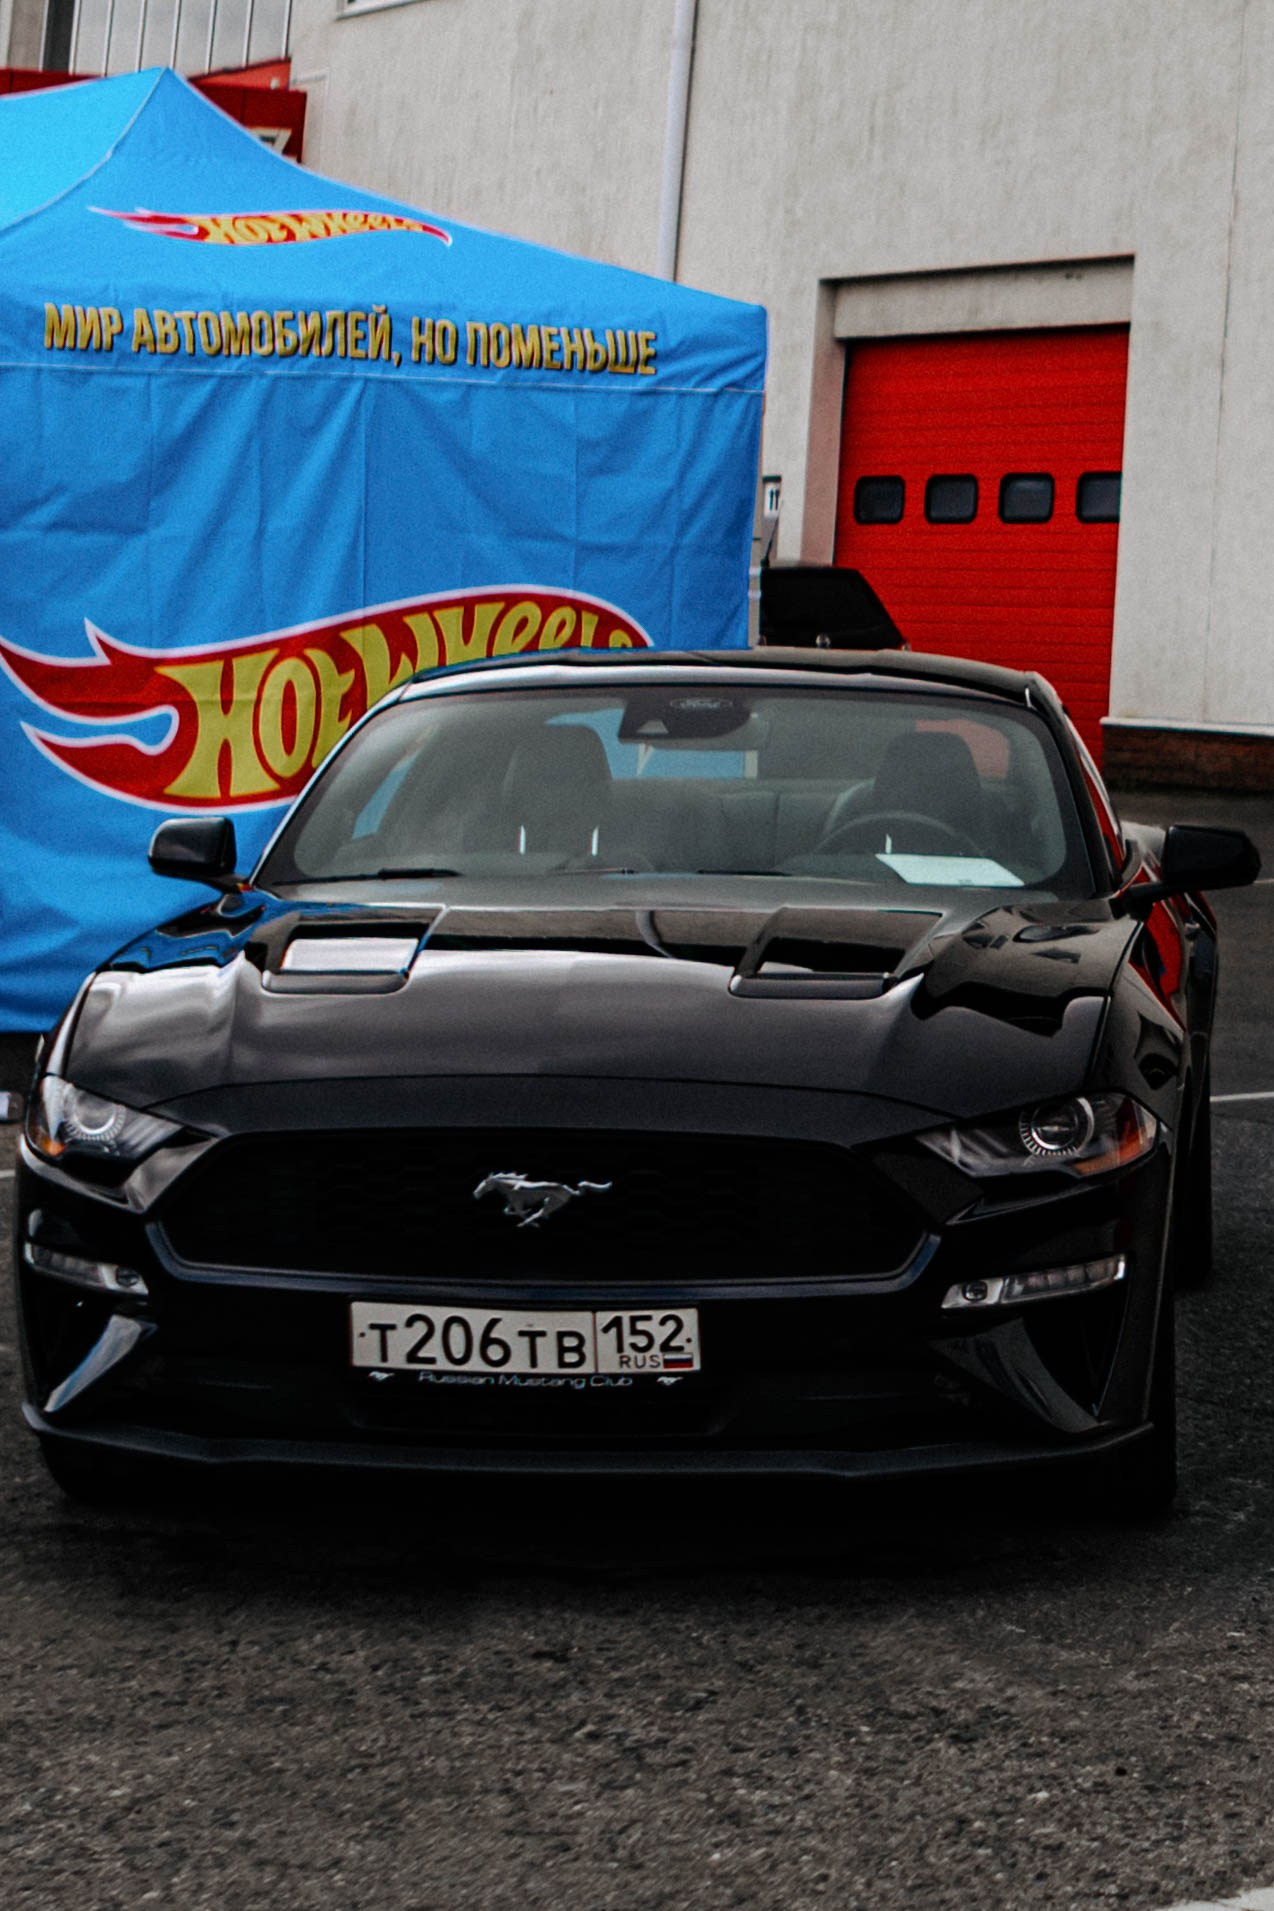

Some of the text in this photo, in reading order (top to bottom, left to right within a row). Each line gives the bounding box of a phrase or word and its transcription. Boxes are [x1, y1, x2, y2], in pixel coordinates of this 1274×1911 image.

[43, 303, 657, 375] МИР АВТОМОБИЛЕЙ, НО ПОМЕНЬШЕ
[600, 1314, 685, 1354] 152
[619, 1354, 661, 1370] RUS
[418, 1371, 633, 1389] Russian Mustang Club
